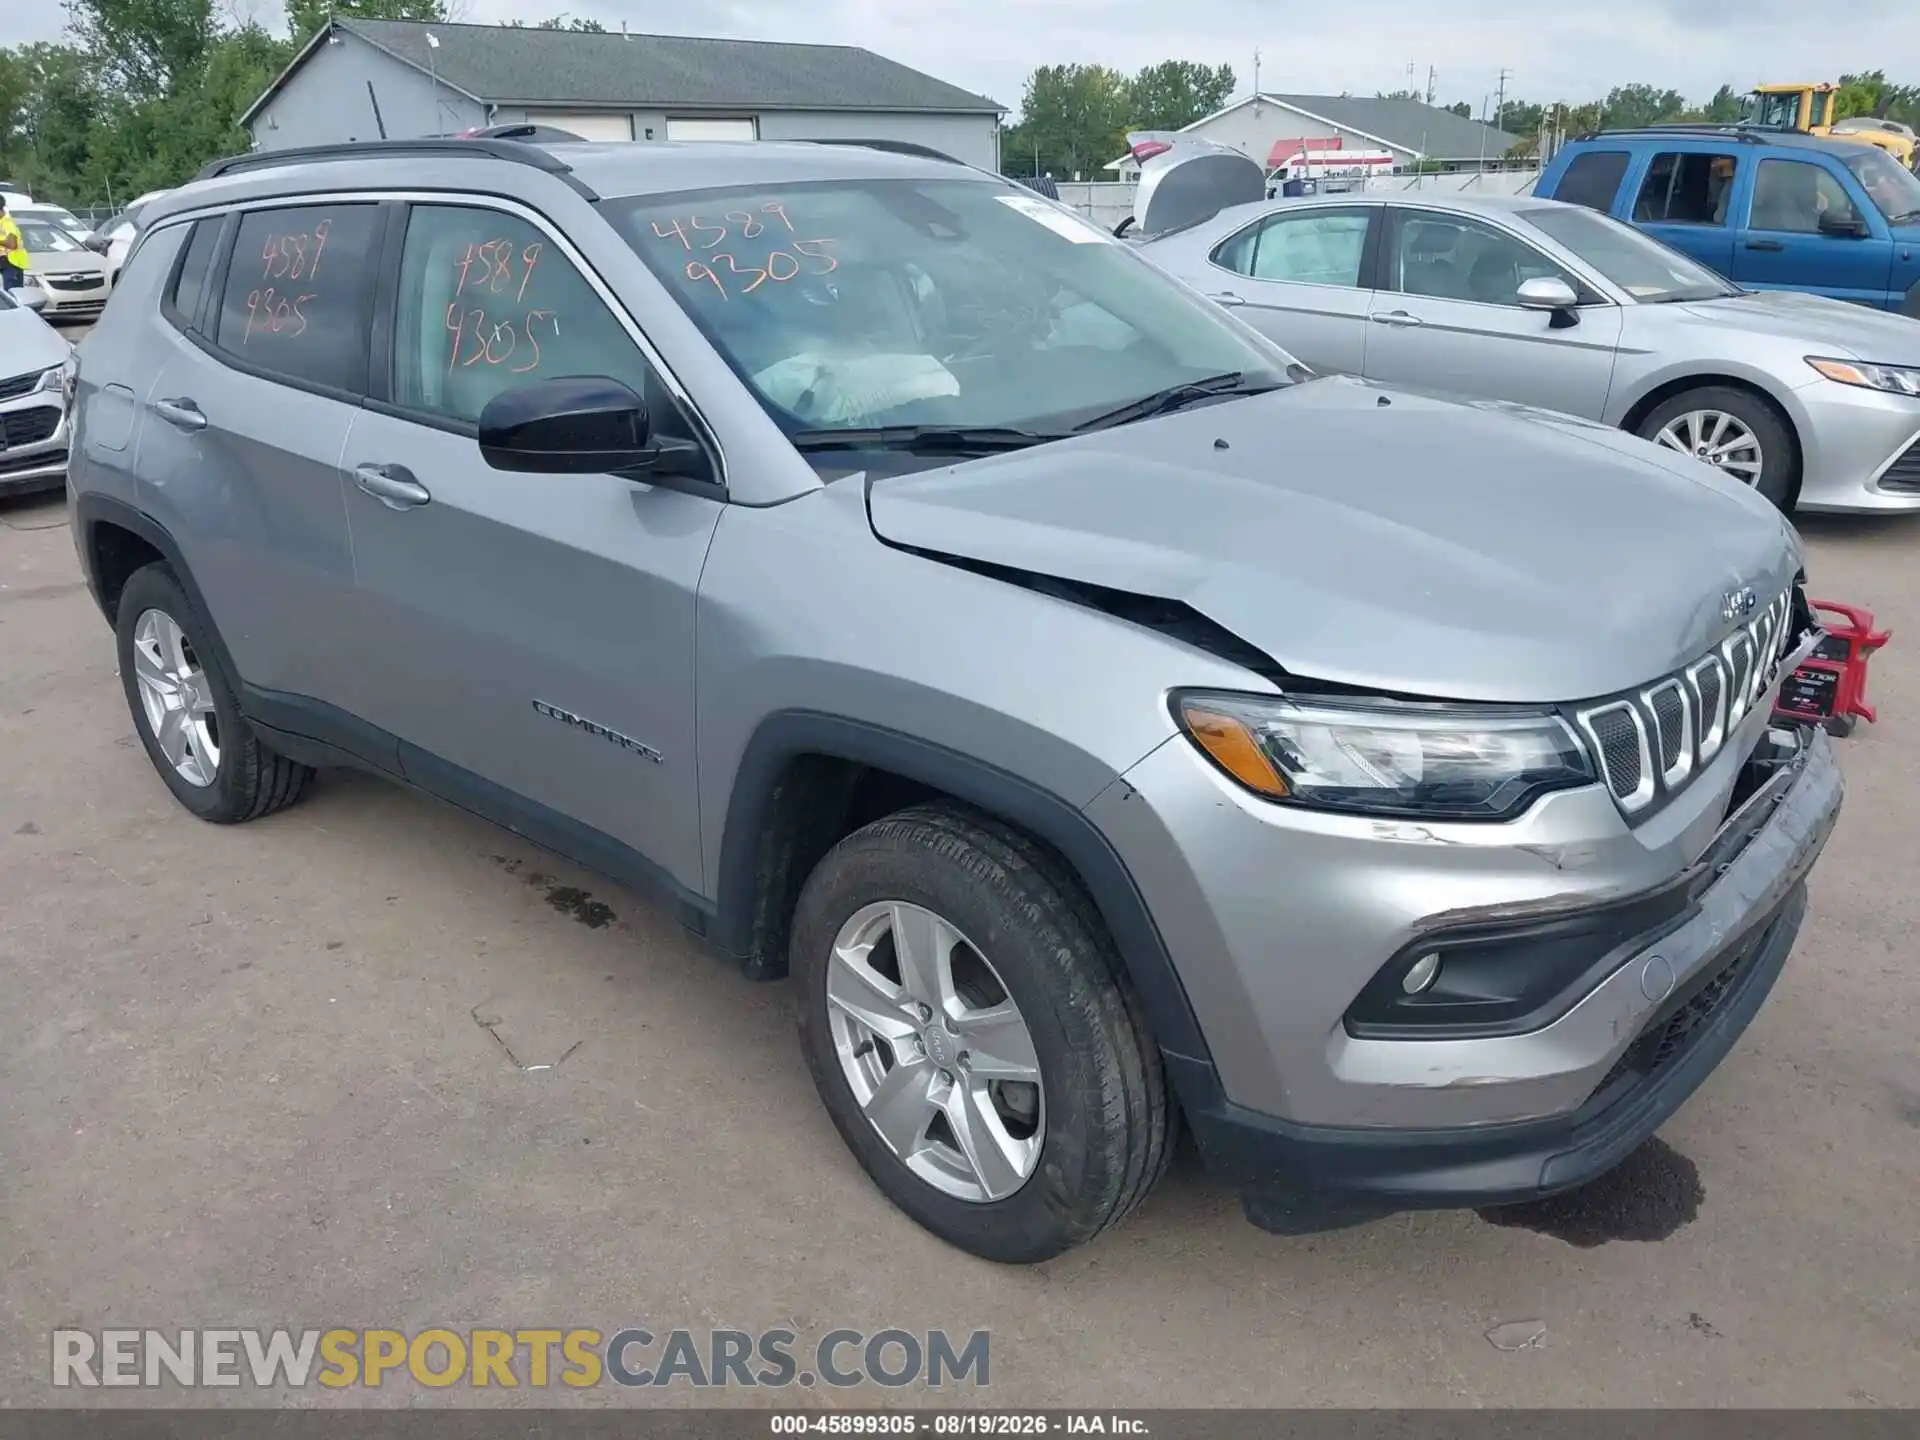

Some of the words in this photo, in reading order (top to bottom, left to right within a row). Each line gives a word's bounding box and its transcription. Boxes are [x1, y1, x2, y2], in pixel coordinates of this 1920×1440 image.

[262, 218, 332, 281] 4589
[652, 202, 794, 250] 4589
[453, 238, 543, 305] 4589
[685, 238, 838, 301] 9305
[243, 287, 318, 345] 9305
